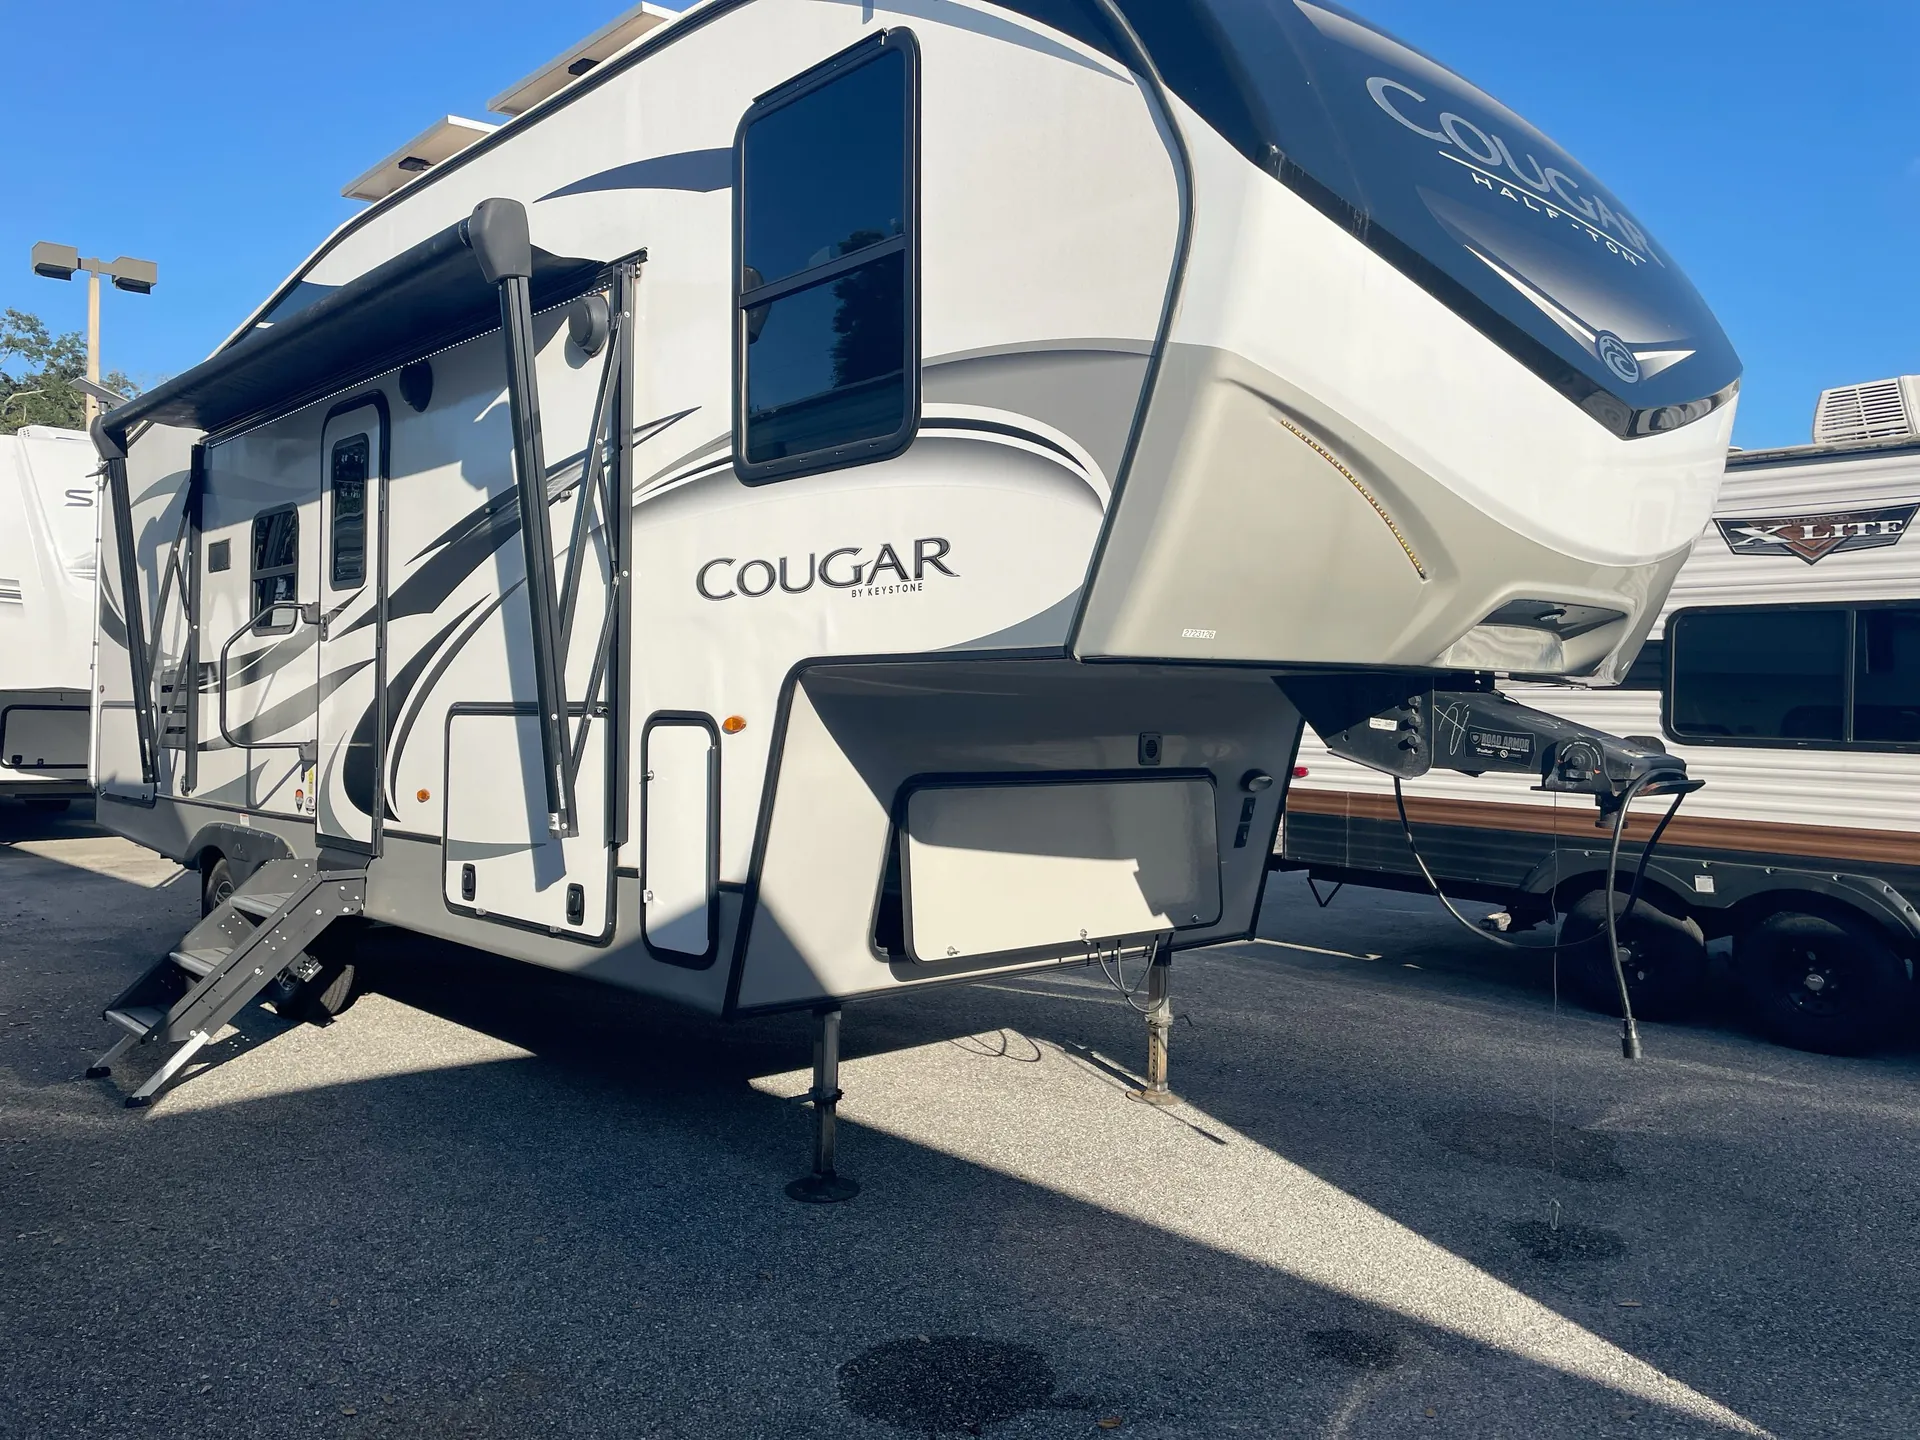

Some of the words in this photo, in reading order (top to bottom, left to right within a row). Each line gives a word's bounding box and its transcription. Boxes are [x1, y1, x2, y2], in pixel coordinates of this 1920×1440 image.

[1365, 76, 1665, 268] COUGAR
[1799, 519, 1904, 541] LITE
[695, 536, 961, 602] COUGAR
[851, 588, 864, 598] BY
[867, 582, 923, 597] KEYSTONE
[1481, 733, 1502, 746] ROAD
[1502, 735, 1531, 750] ARMOR
